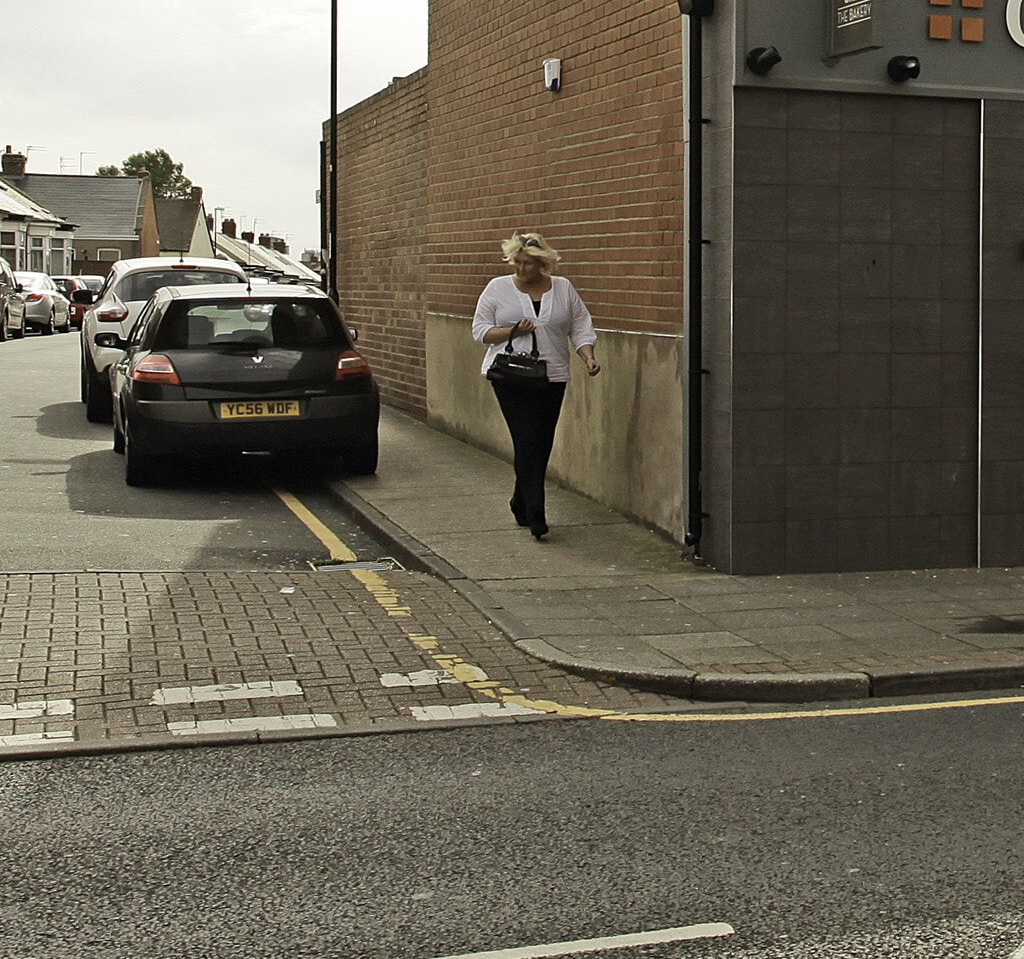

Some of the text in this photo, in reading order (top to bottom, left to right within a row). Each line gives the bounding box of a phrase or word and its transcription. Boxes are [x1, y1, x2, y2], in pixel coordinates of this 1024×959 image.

[837, 3, 872, 24] THE BAKERY
[226, 402, 294, 416] YC56 WDF
